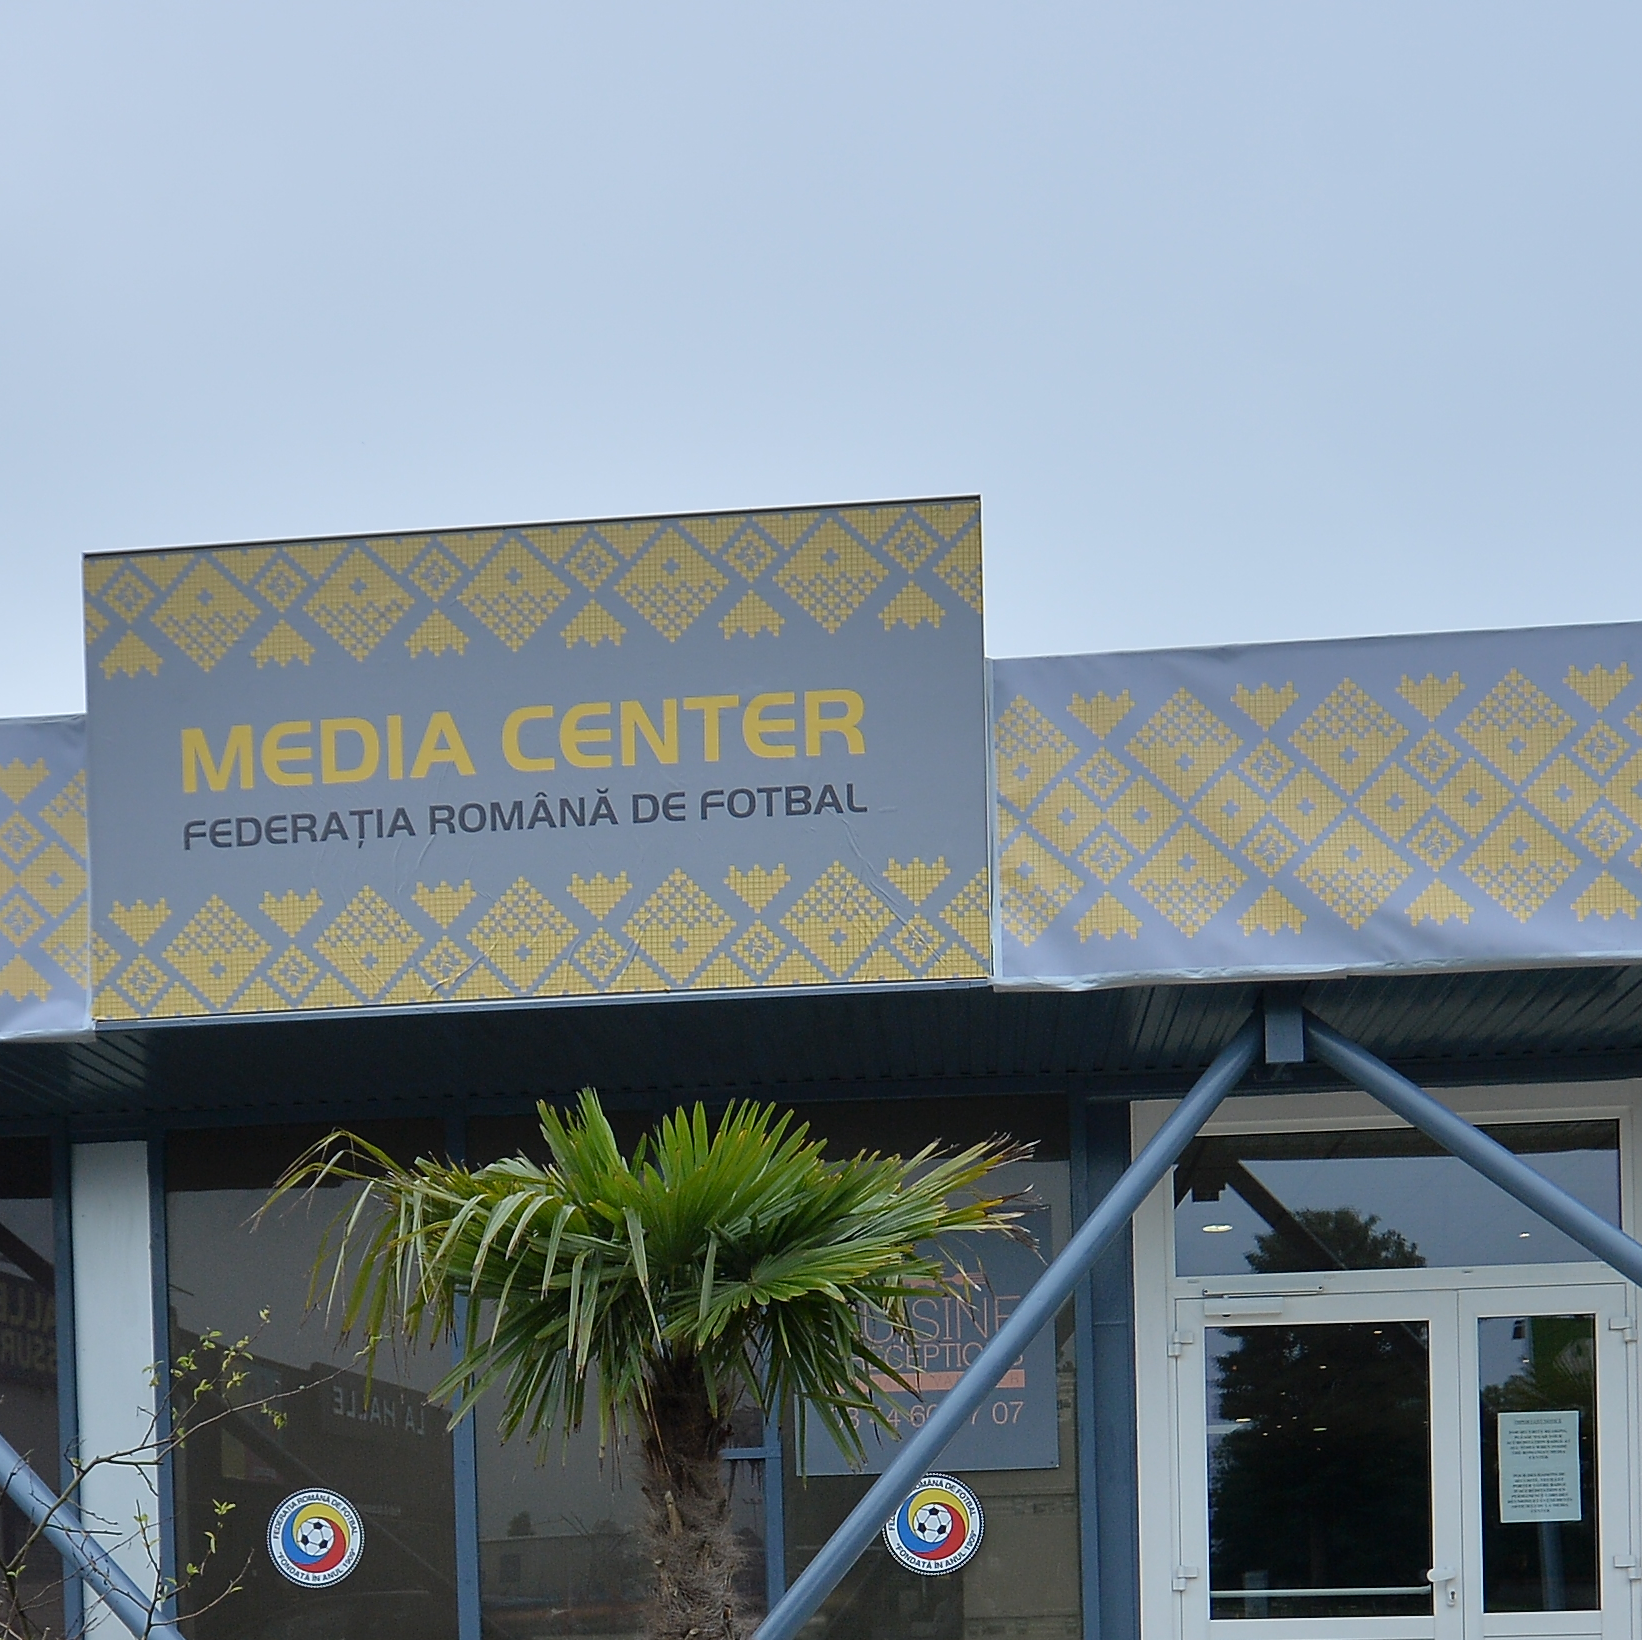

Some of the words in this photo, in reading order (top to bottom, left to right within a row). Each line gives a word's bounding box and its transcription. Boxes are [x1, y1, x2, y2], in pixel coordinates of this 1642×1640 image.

[181, 710, 476, 793] MEDIA
[501, 688, 866, 772] CENTER
[183, 806, 416, 850] FEDERAȚIA
[429, 788, 619, 835] ROMÂNĂ
[632, 791, 686, 824] DE
[700, 783, 868, 820] FOTBAL
[991, 1400, 1024, 1426] 07
